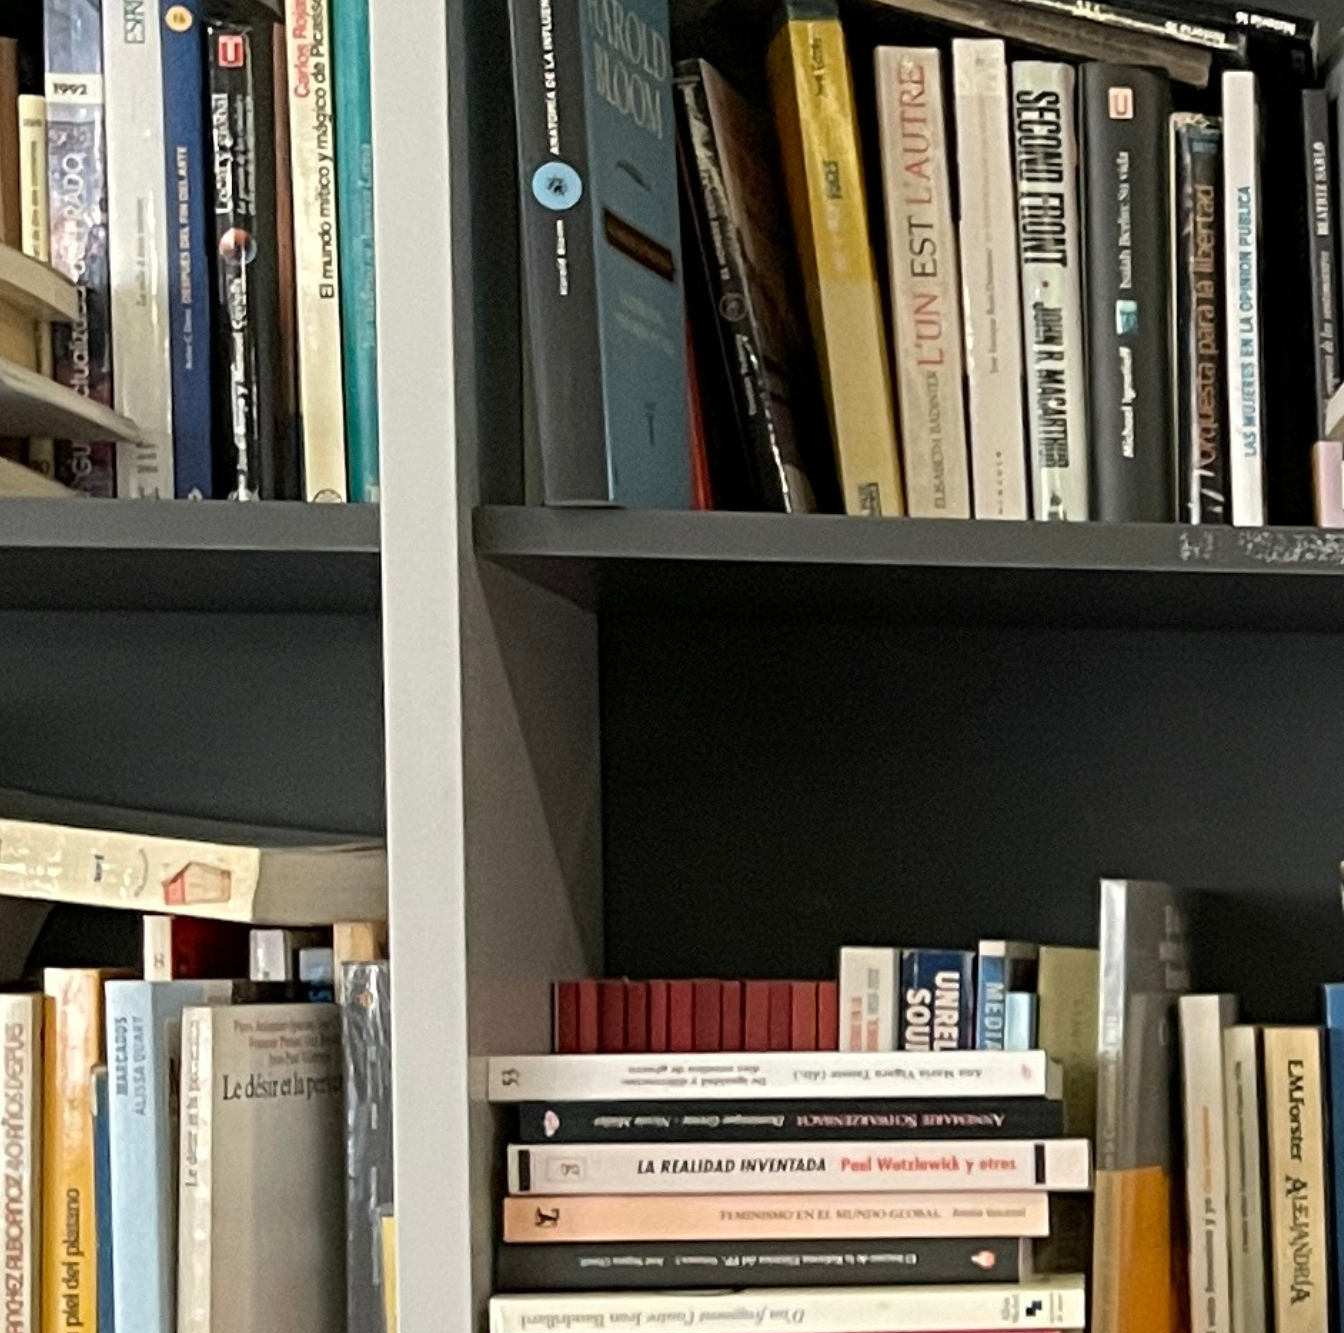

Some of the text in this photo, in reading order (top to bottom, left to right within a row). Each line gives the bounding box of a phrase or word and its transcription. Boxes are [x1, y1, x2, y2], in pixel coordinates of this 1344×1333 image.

[1014, 88, 1067, 267] SECOND FRONT
[908, 213, 939, 278] EST
[912, 291, 946, 366] L'UN
[636, 1156, 827, 1174] LA REALIDAD INVENTADA
